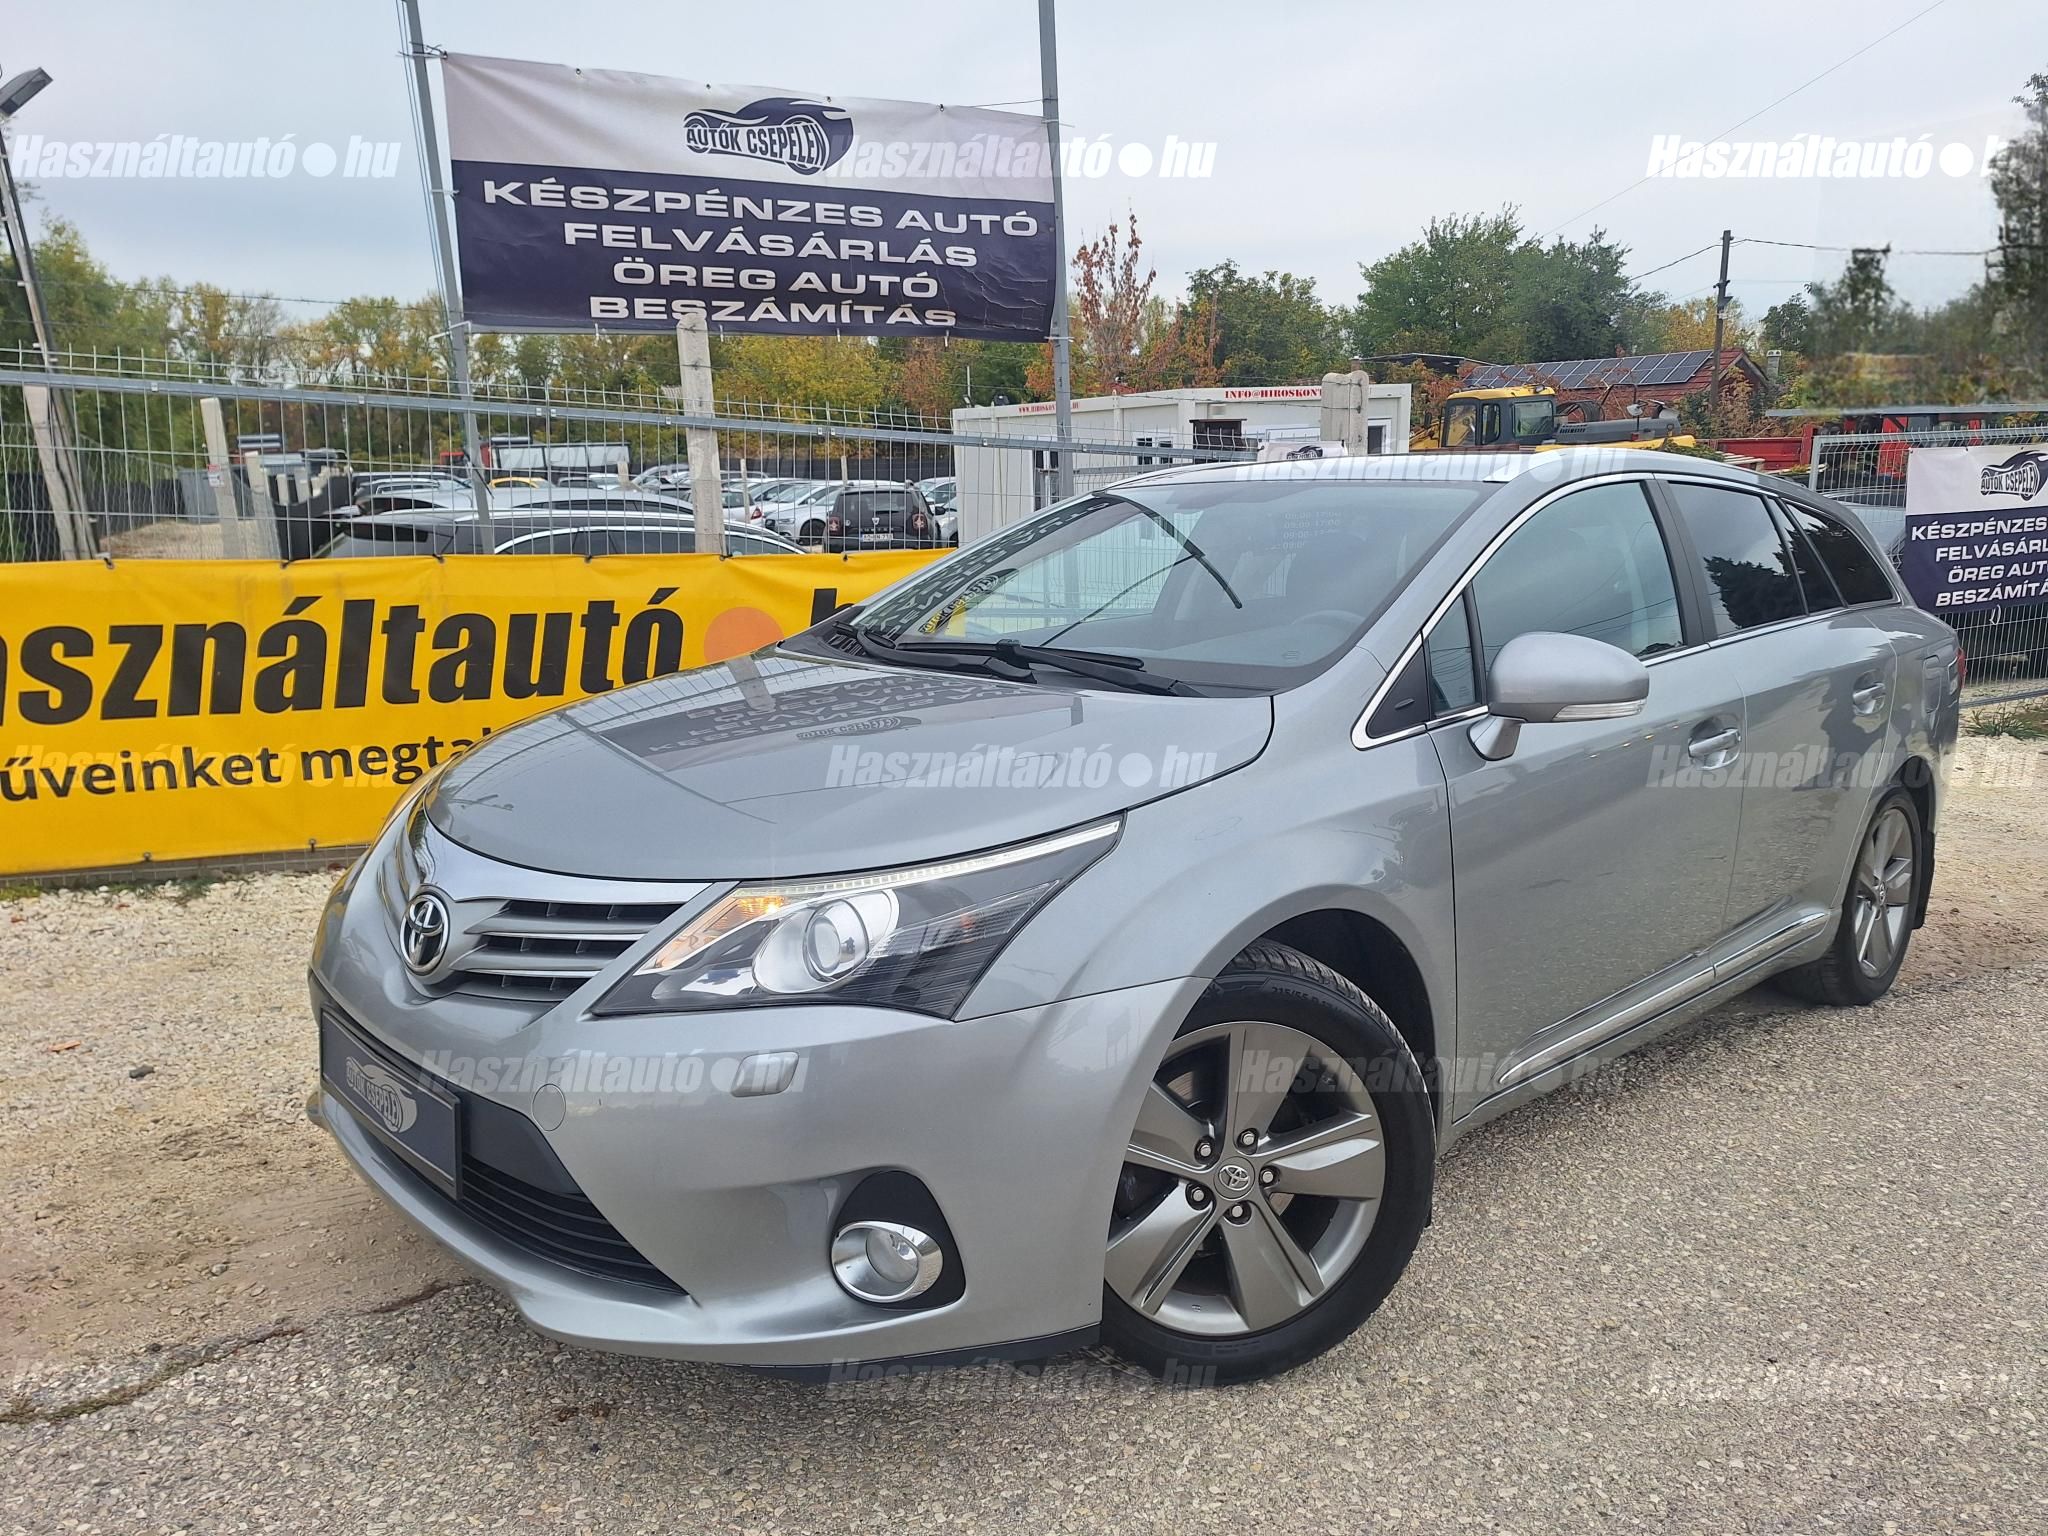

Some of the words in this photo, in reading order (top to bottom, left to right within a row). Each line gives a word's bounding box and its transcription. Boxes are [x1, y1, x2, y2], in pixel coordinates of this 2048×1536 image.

[686, 123, 742, 152] AUTÓK
[746, 122, 827, 167] CSEPELEN
[482, 177, 883, 228] KÉSZPÉNZES
[895, 209, 1039, 238] AUTÓ
[563, 222, 977, 268] FELVÁSÁRLÁS
[613, 257, 776, 291] ÖREG
[788, 271, 939, 299] AUTÓ
[589, 296, 957, 327] BESZÁMÍTÁS
[1911, 517, 2048, 541] KÉSZPÉNZES
[1948, 565, 2005, 583] ÖREG
[2007, 560, 2048, 578] AUT
[0, 587, 681, 726] sználtautó
